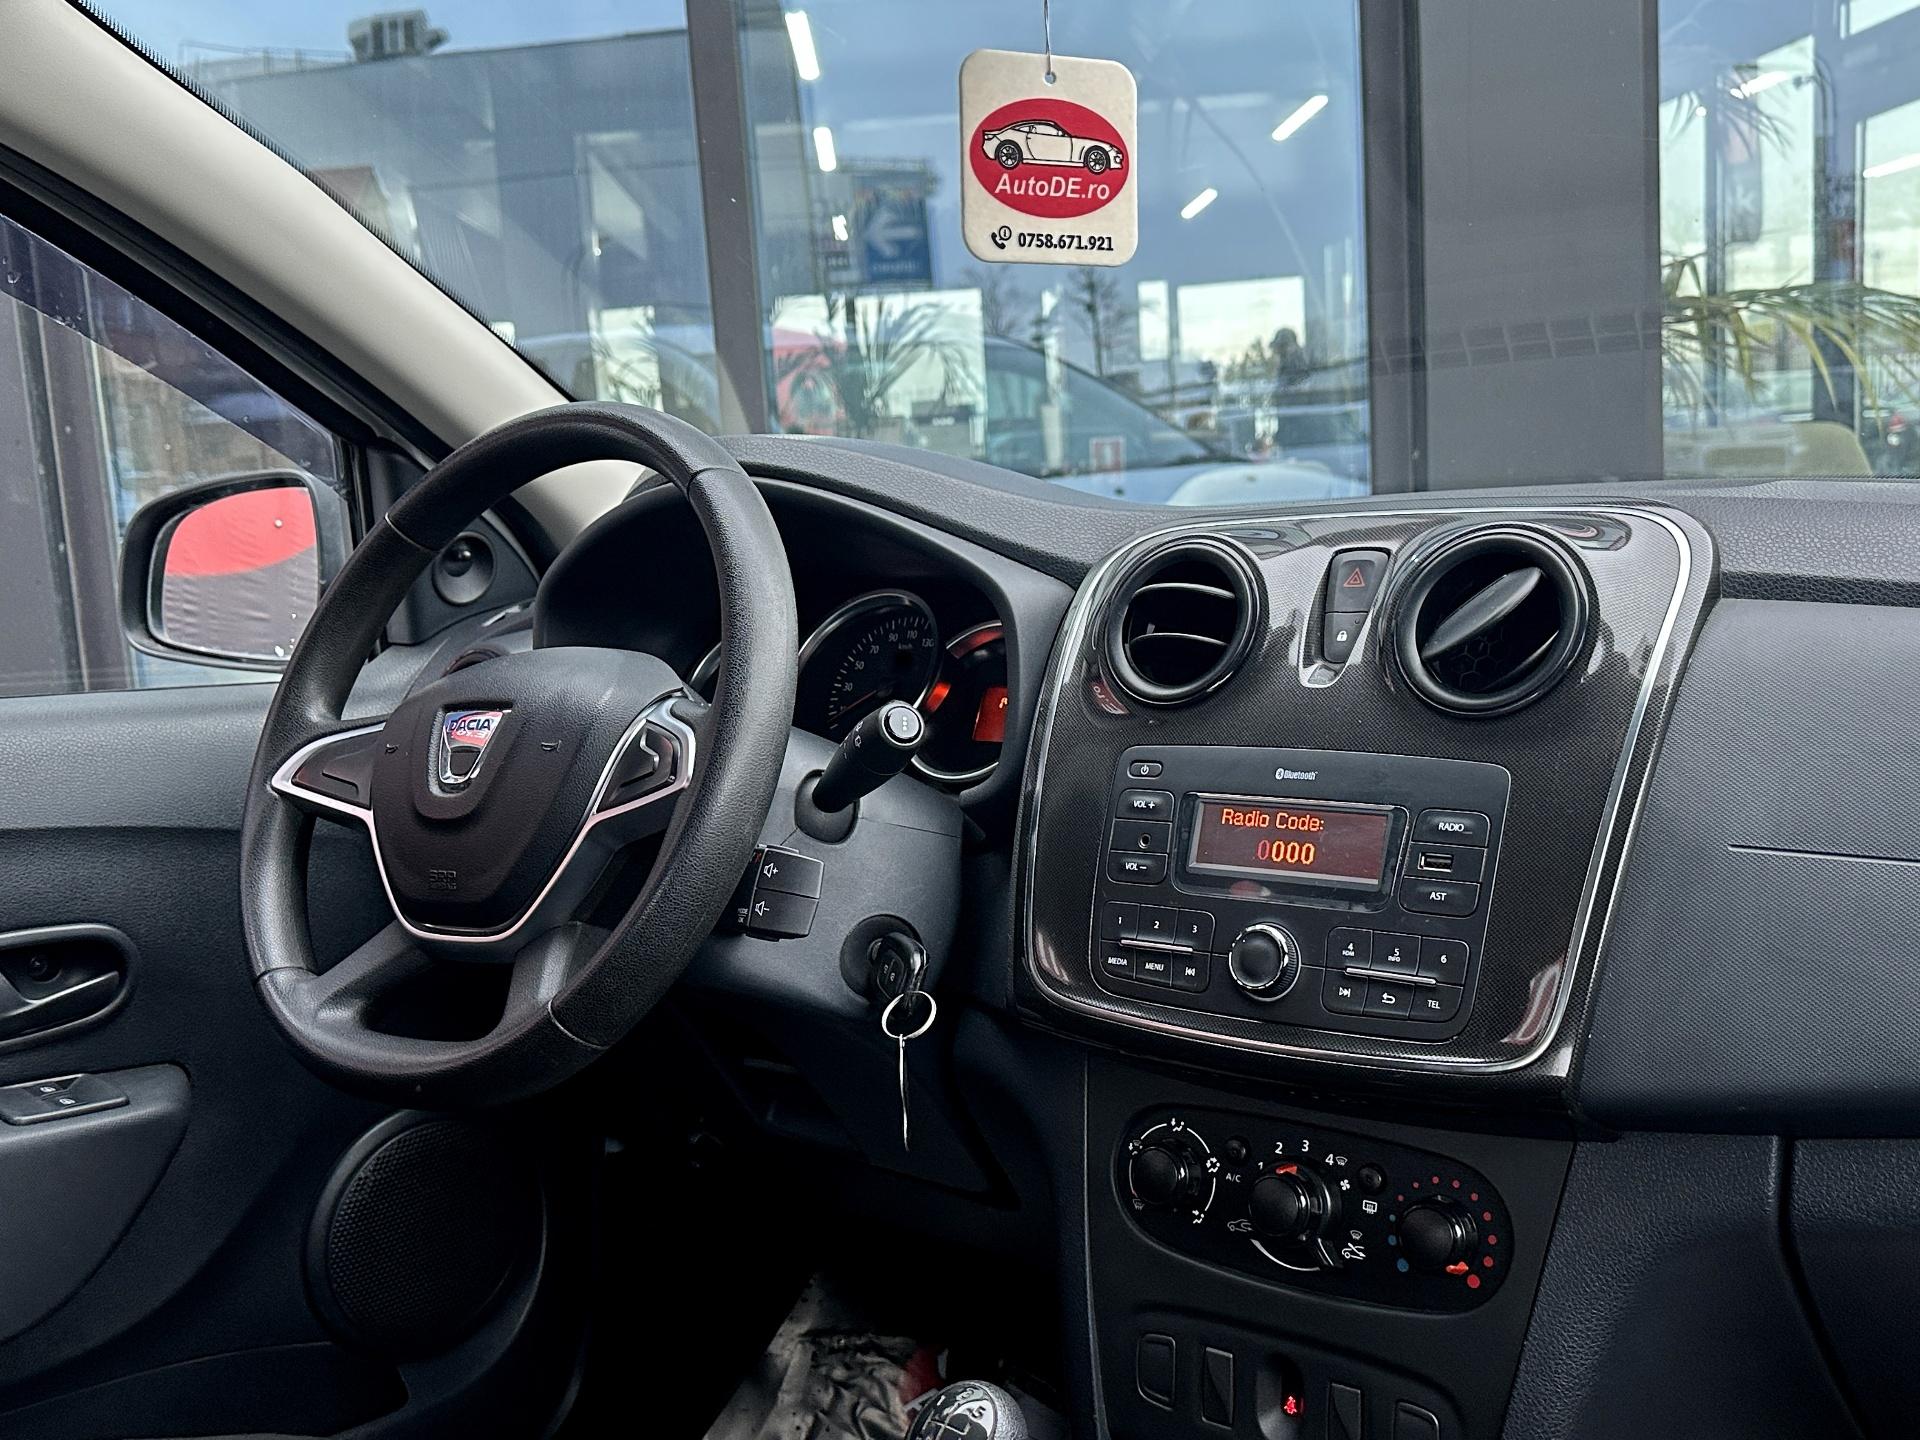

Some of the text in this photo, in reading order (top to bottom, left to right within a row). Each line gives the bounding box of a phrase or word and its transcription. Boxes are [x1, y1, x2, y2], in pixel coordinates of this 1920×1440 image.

[995, 173, 1110, 200] AutoDE.ro
[1018, 232, 1114, 251] 0758.671.921
[869, 645, 880, 654] 70
[854, 660, 865, 670] 50
[448, 718, 491, 731] DACIA
[1133, 800, 1147, 809] VOL
[1221, 808, 1325, 832] Radio Code:
[1438, 822, 1465, 832] RADIO
[1257, 839, 1315, 865] 0000
[1125, 862, 1138, 871] VOL
[1429, 892, 1447, 902] AST
[1153, 921, 1160, 929] 2
[1192, 925, 1198, 933] 3
[1347, 942, 1354, 951] 4
[1394, 948, 1400, 956] 5
[1108, 956, 1128, 966] MEDIA
[1440, 955, 1447, 964] 6
[1145, 962, 1164, 972] MENU
[1427, 999, 1440, 1009] TEL
[1274, 1142, 1283, 1155] 2
[1301, 1139, 1310, 1152] 3
[1325, 1153, 1334, 1166] 4
[1225, 1172, 1241, 1183] A/C
